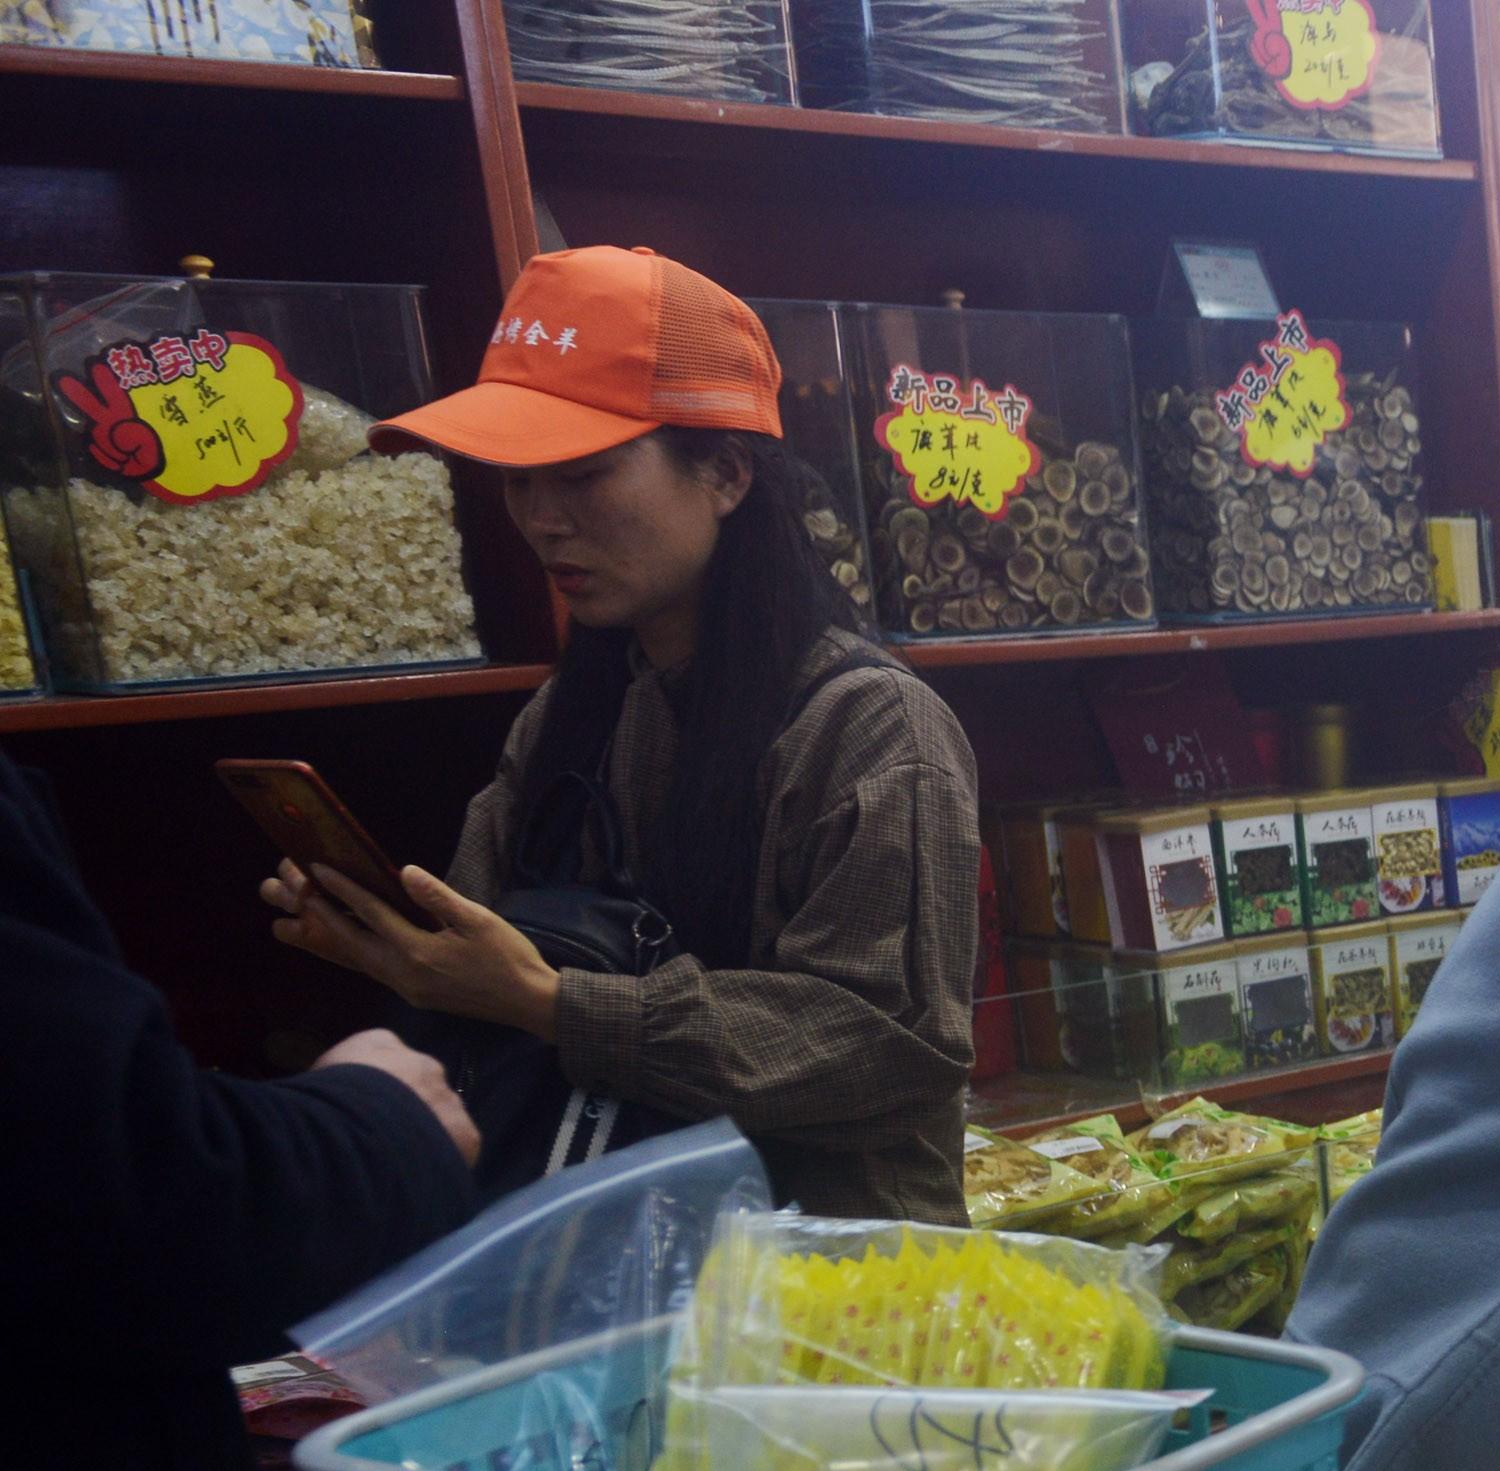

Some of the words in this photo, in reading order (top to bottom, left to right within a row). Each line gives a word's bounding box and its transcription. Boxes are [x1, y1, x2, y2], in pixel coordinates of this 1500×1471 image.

[106, 329, 229, 391] 热卖中
[1215, 313, 1309, 432] 新品上市
[890, 365, 1030, 434] 新品上市
